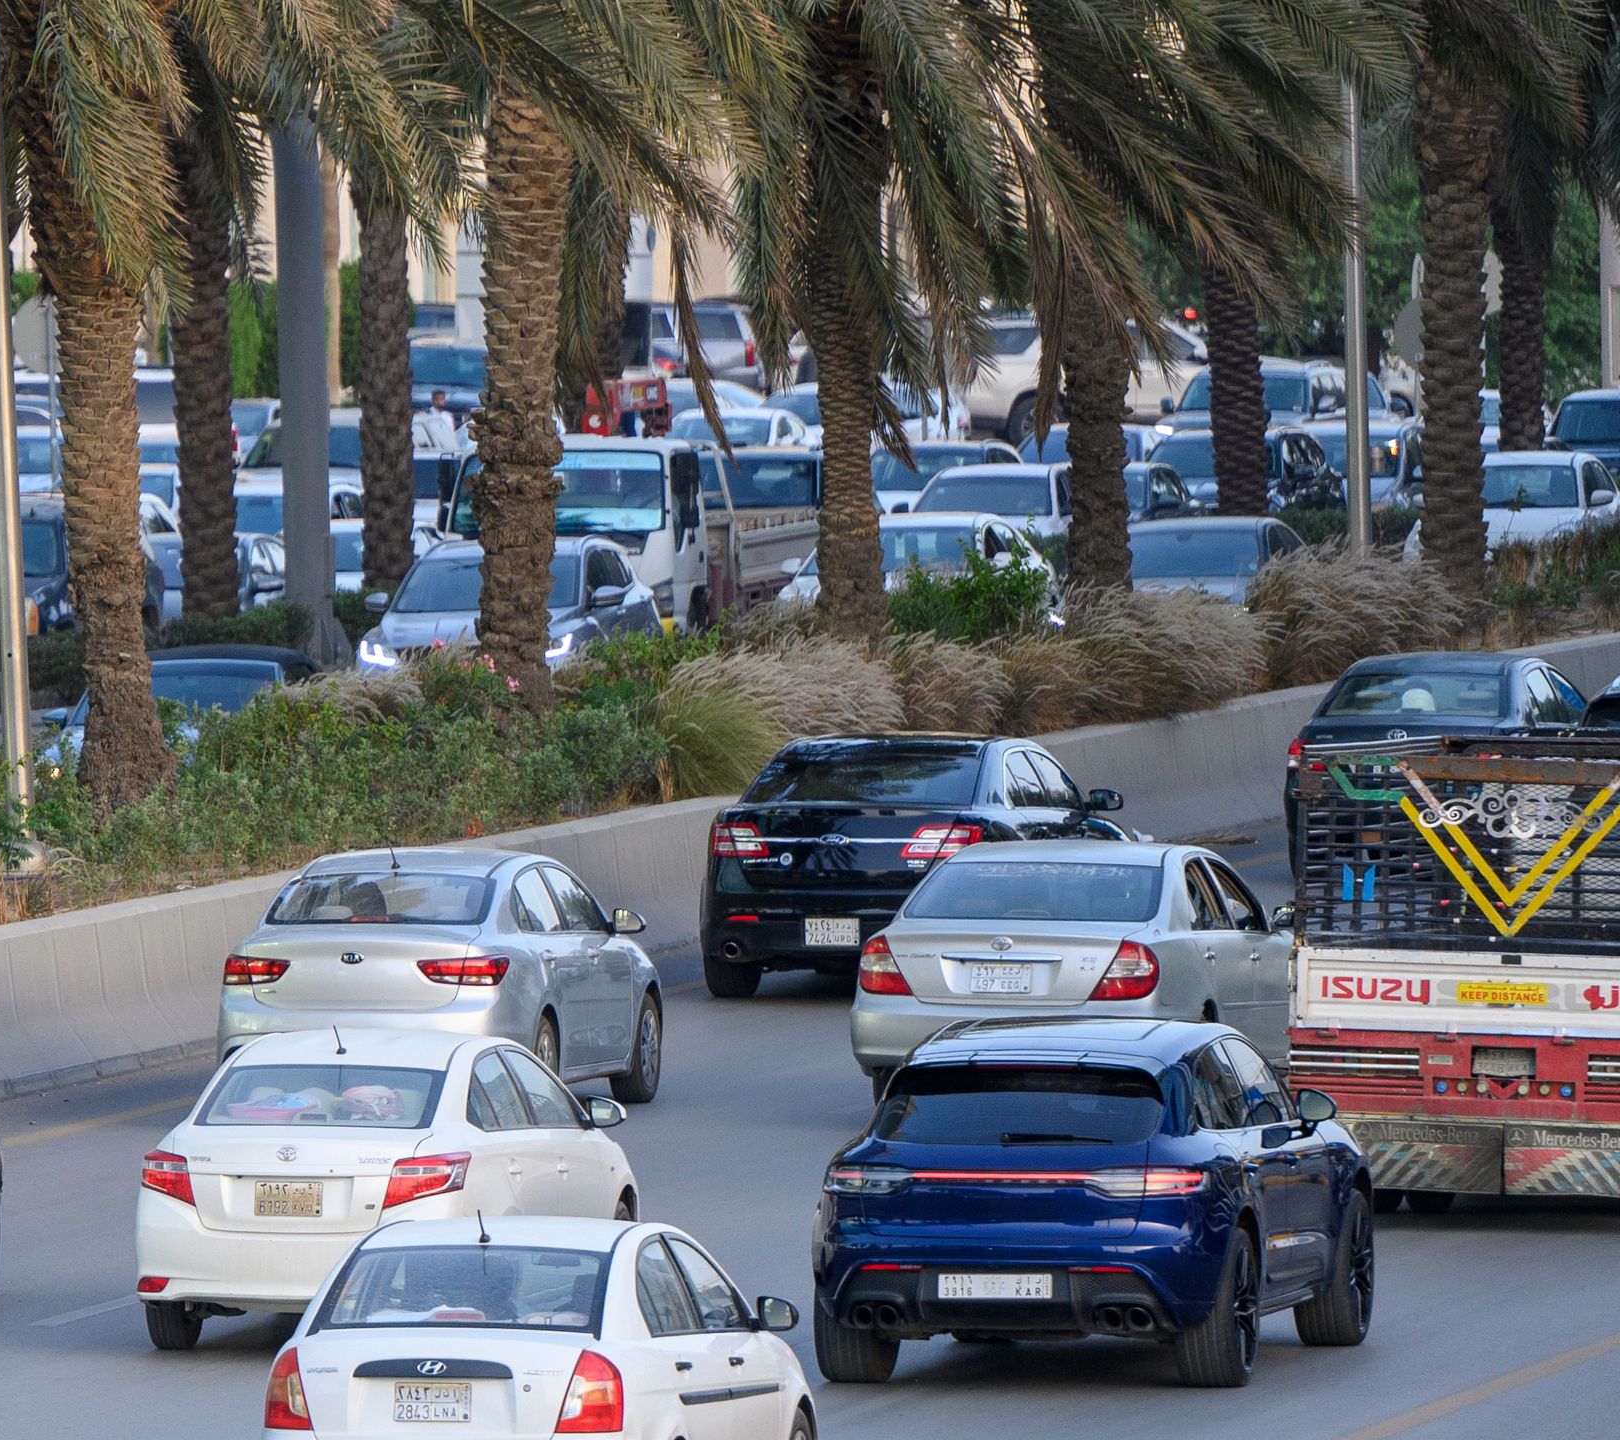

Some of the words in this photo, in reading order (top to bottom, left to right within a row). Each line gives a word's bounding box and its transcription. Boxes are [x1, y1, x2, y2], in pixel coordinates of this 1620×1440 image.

[808, 933, 831, 944] 7424
[343, 954, 361, 962] KIA
[1321, 976, 1431, 1005] ISUZU
[1461, 990, 1488, 1001] KEEP
[1491, 991, 1545, 1002] DISTANCE
[1379, 1123, 1479, 1143] Mercedes-Benz
[1533, 1130, 1620, 1149] Mercedes-Be
[259, 1200, 288, 1214] 6192
[944, 1287, 973, 1297] 3916
[1015, 1287, 1042, 1297] KAR
[397, 1404, 431, 1420] 2843
[433, 1405, 457, 1418] LNA
